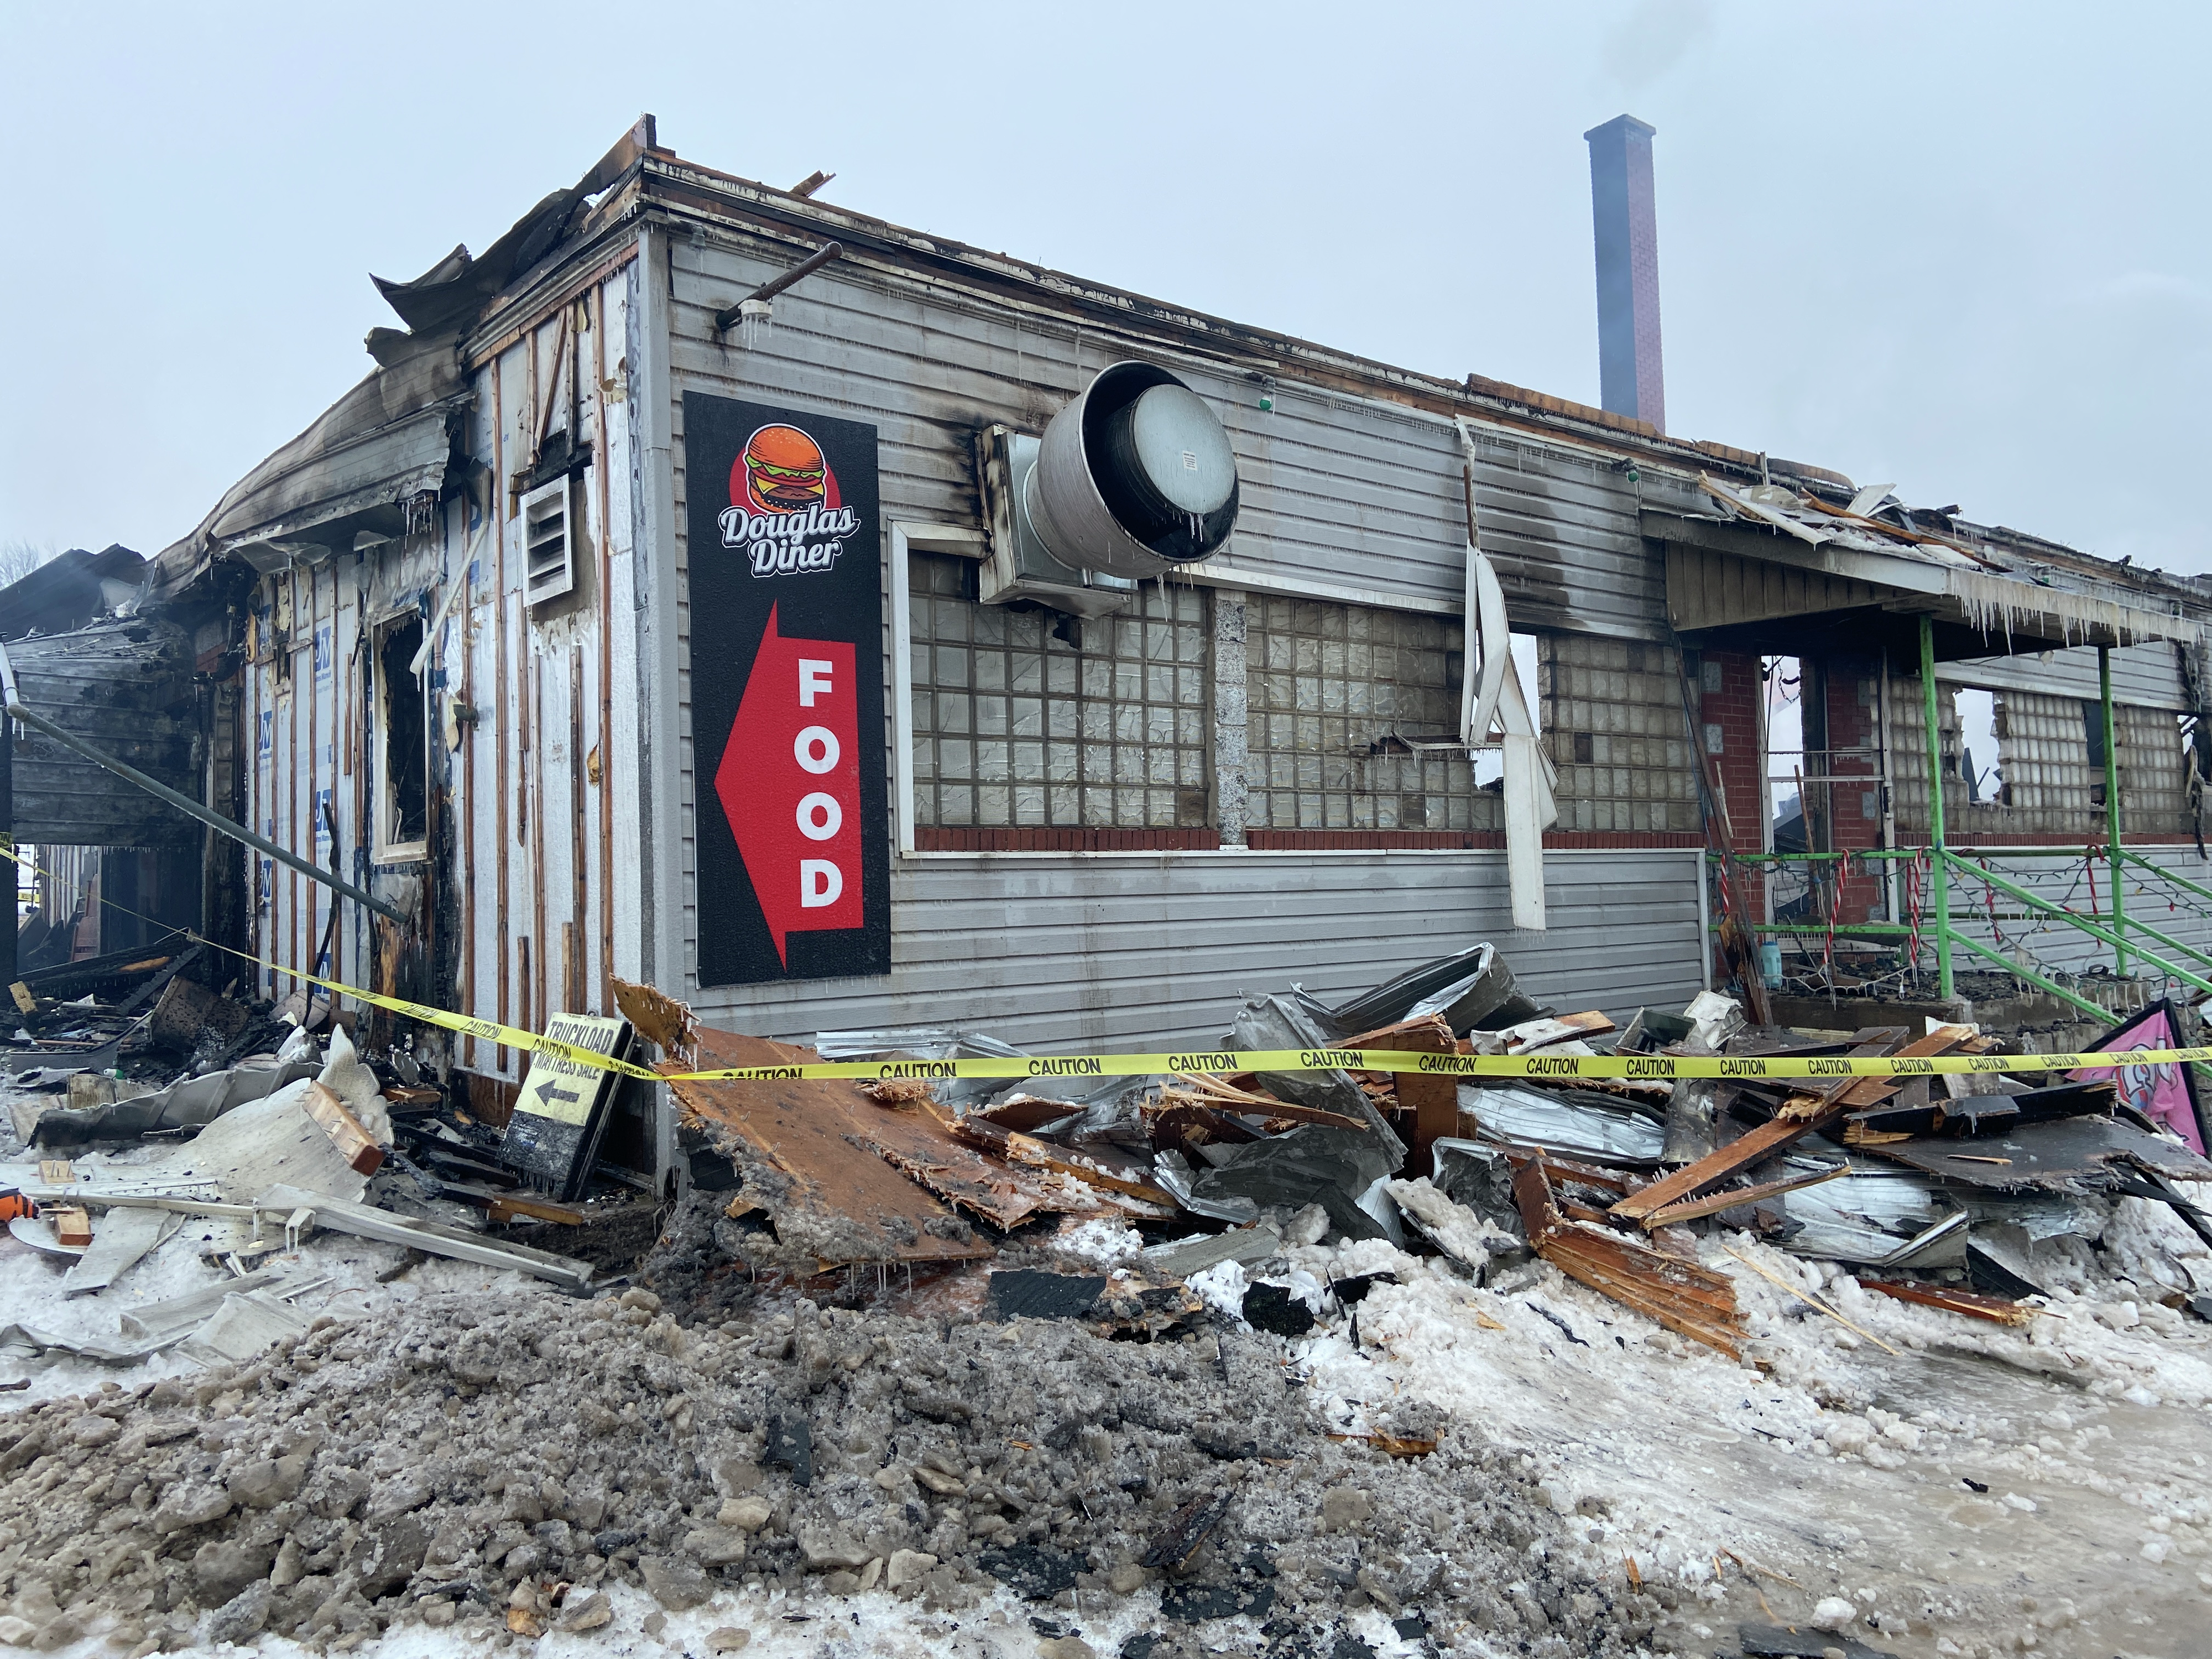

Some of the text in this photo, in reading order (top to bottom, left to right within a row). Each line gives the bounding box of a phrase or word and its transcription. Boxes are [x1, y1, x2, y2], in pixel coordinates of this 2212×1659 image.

[719, 502, 859, 547] Douglas
[749, 539, 842, 577] Diner
[794, 658, 843, 907] FOOD
[459, 1020, 502, 1039] CAUTION
[530, 1039, 571, 1058] CAUTION
[608, 1060, 649, 1076] CAUTIO
[548, 1021, 614, 1055] TRUCKLOAD
[577, 1064, 600, 1079] SALE
[880, 1062, 957, 1077] CAUTION
[1029, 1058, 1102, 1075] CAUTION
[1168, 1054, 1238, 1071] CAUTION
[1300, 1052, 1364, 1067] CAUTION
[1418, 1055, 1477, 1072] CAUTION
[1526, 1058, 1579, 1075] CAUTION
[1626, 1059, 1675, 1075] CAUTION
[1720, 1060, 1766, 1075] CAUTION
[1808, 1060, 1852, 1074] CAUTION
[1891, 1059, 1933, 1073] CAUTION
[1968, 1057, 2010, 1071] CAUTION
[2041, 1055, 2081, 1067] CAUTION
[2109, 1052, 2148, 1063] CAUTION
[2173, 1048, 2211, 1060] CAUTION
